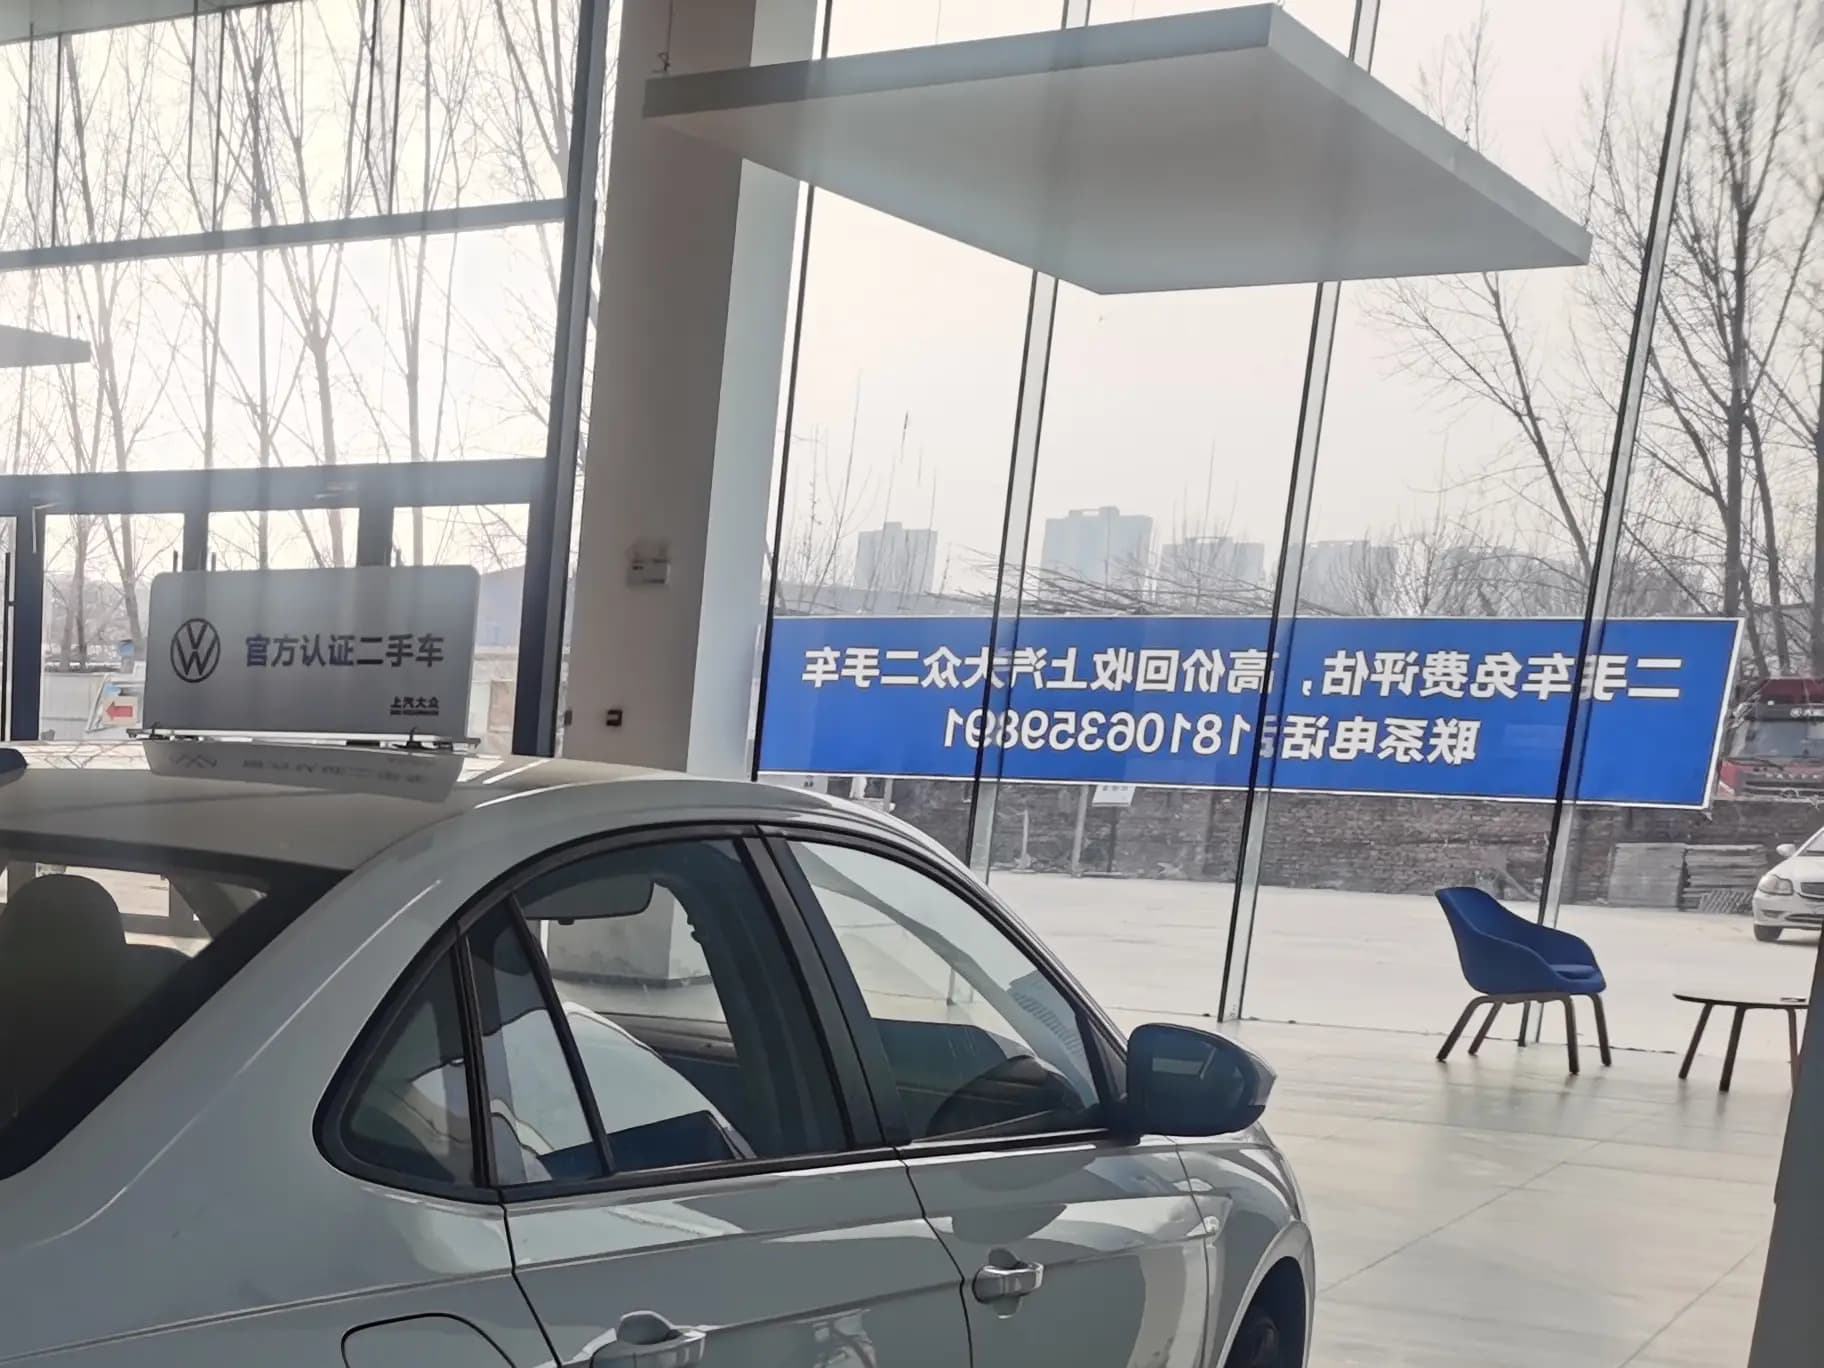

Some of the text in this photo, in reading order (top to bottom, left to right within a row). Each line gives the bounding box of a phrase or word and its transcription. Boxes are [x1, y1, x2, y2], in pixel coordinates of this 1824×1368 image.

[245, 633, 445, 669] 官方认证二手车
